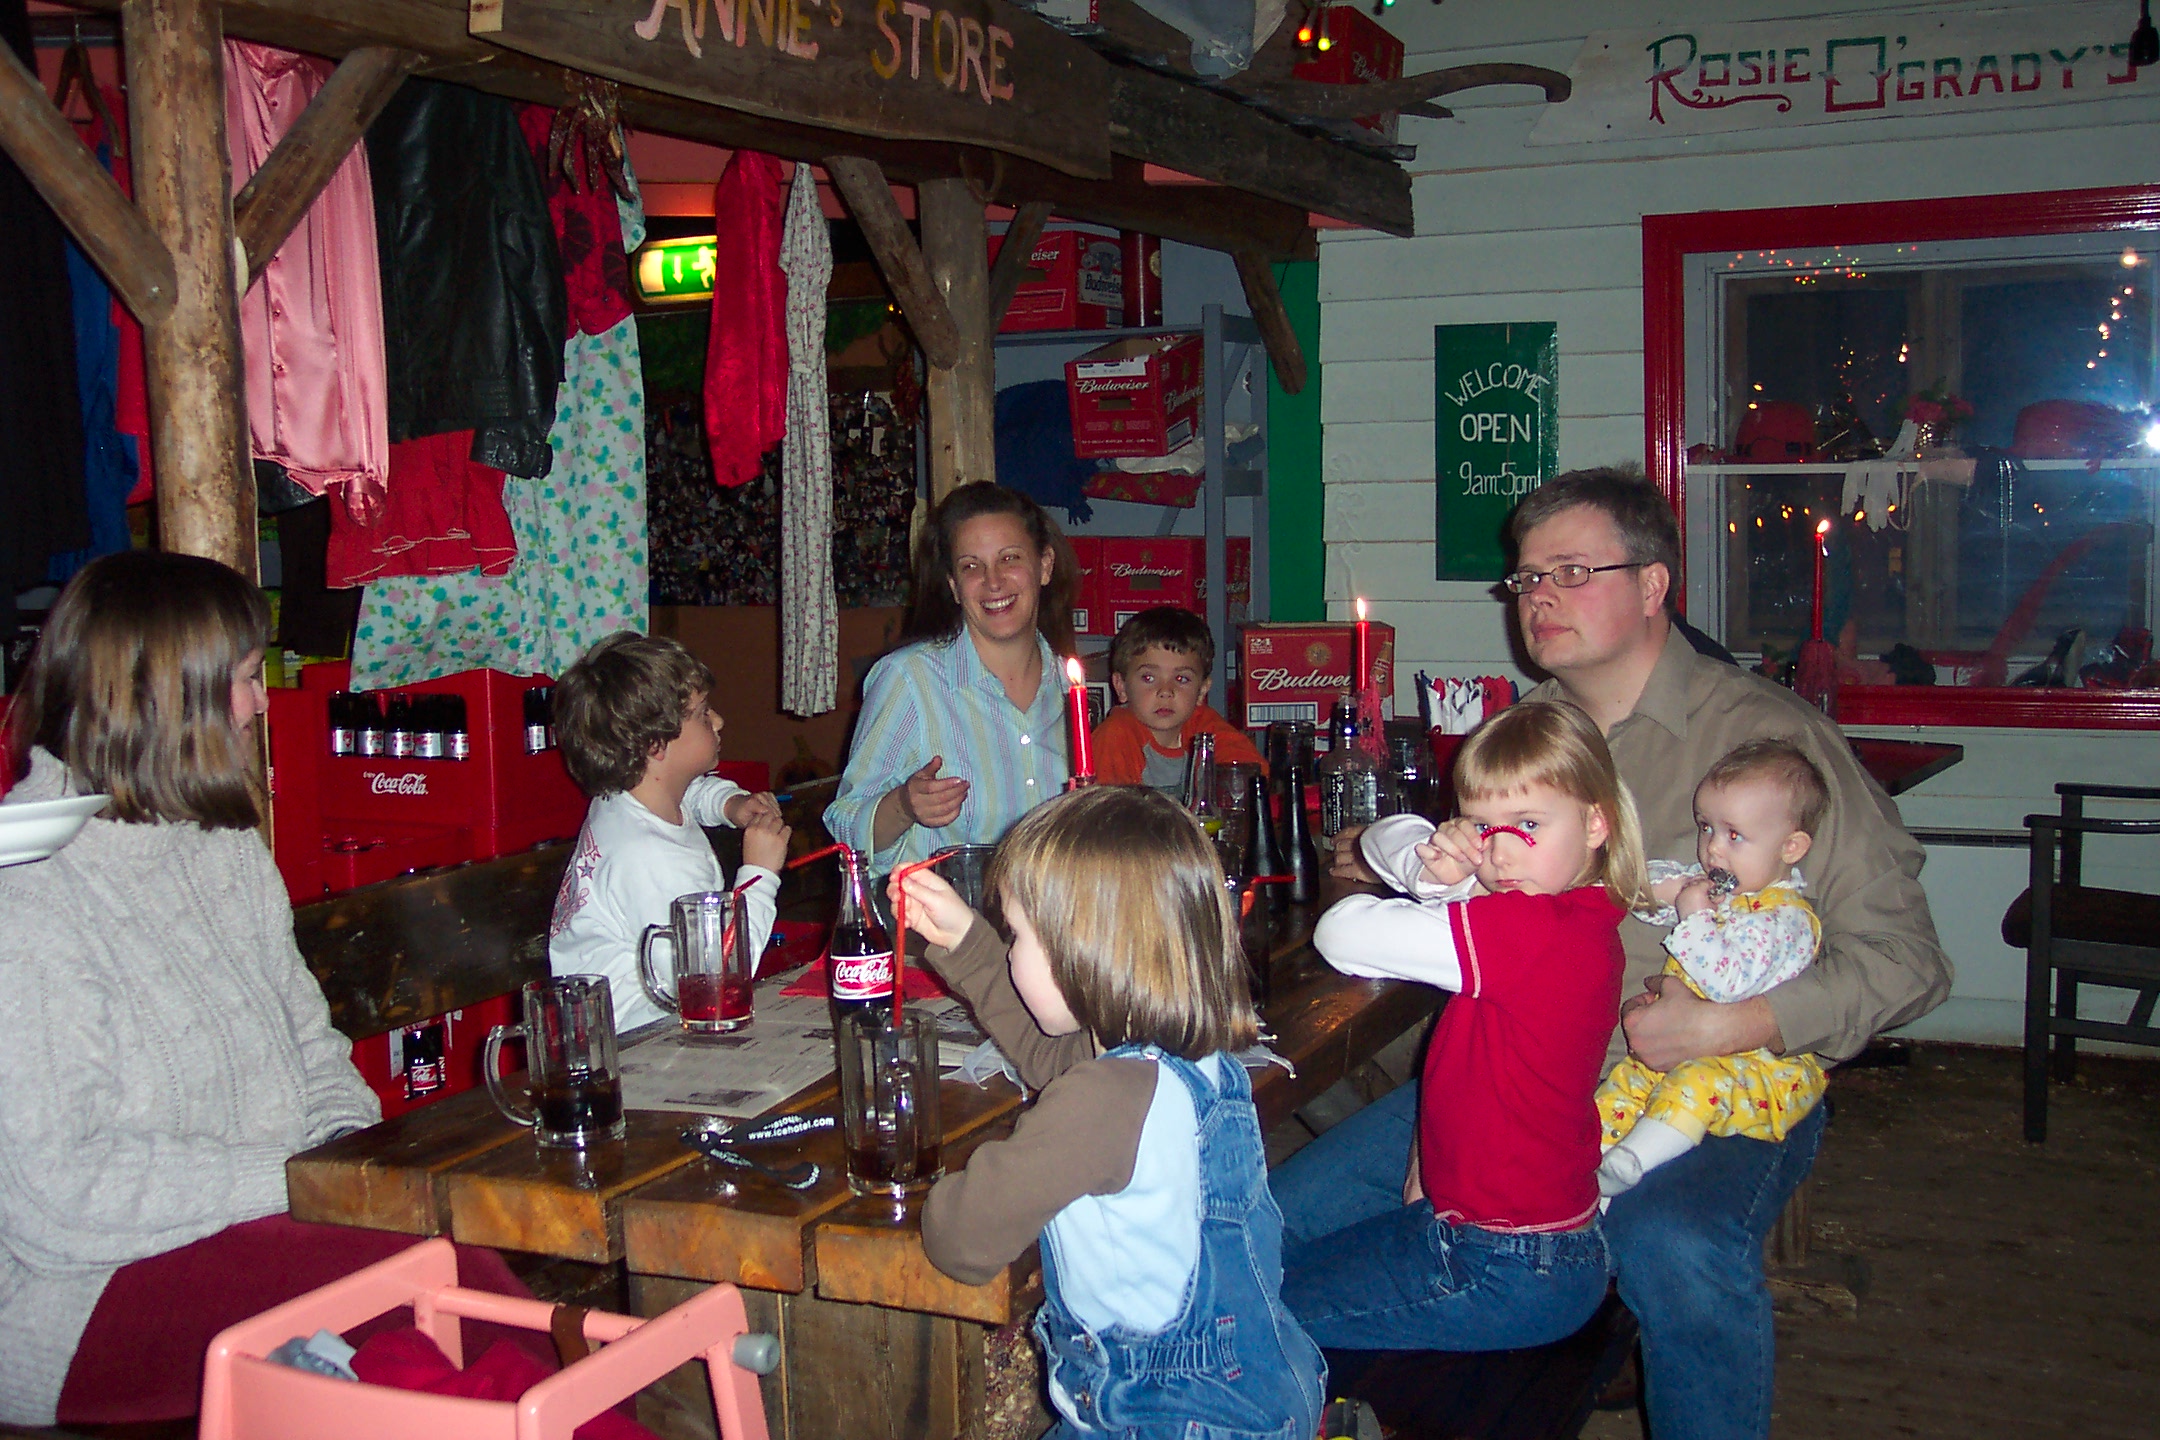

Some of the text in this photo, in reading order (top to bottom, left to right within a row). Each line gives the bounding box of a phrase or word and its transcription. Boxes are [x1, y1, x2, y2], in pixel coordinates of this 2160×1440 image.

[870, 0, 1014, 105] STORE
[1646, 33, 1811, 125] ROSIE
[1074, 379, 1150, 394] Budweiser
[1444, 362, 1550, 407] WELCOME
[1459, 412, 1531, 443] OPEN
[1110, 563, 1182, 578] Budweiser
[371, 771, 429, 795] Coca-Cola
[835, 957, 891, 984] Coca-Cola
[748, 1117, 835, 1140] www.icehotel.com
